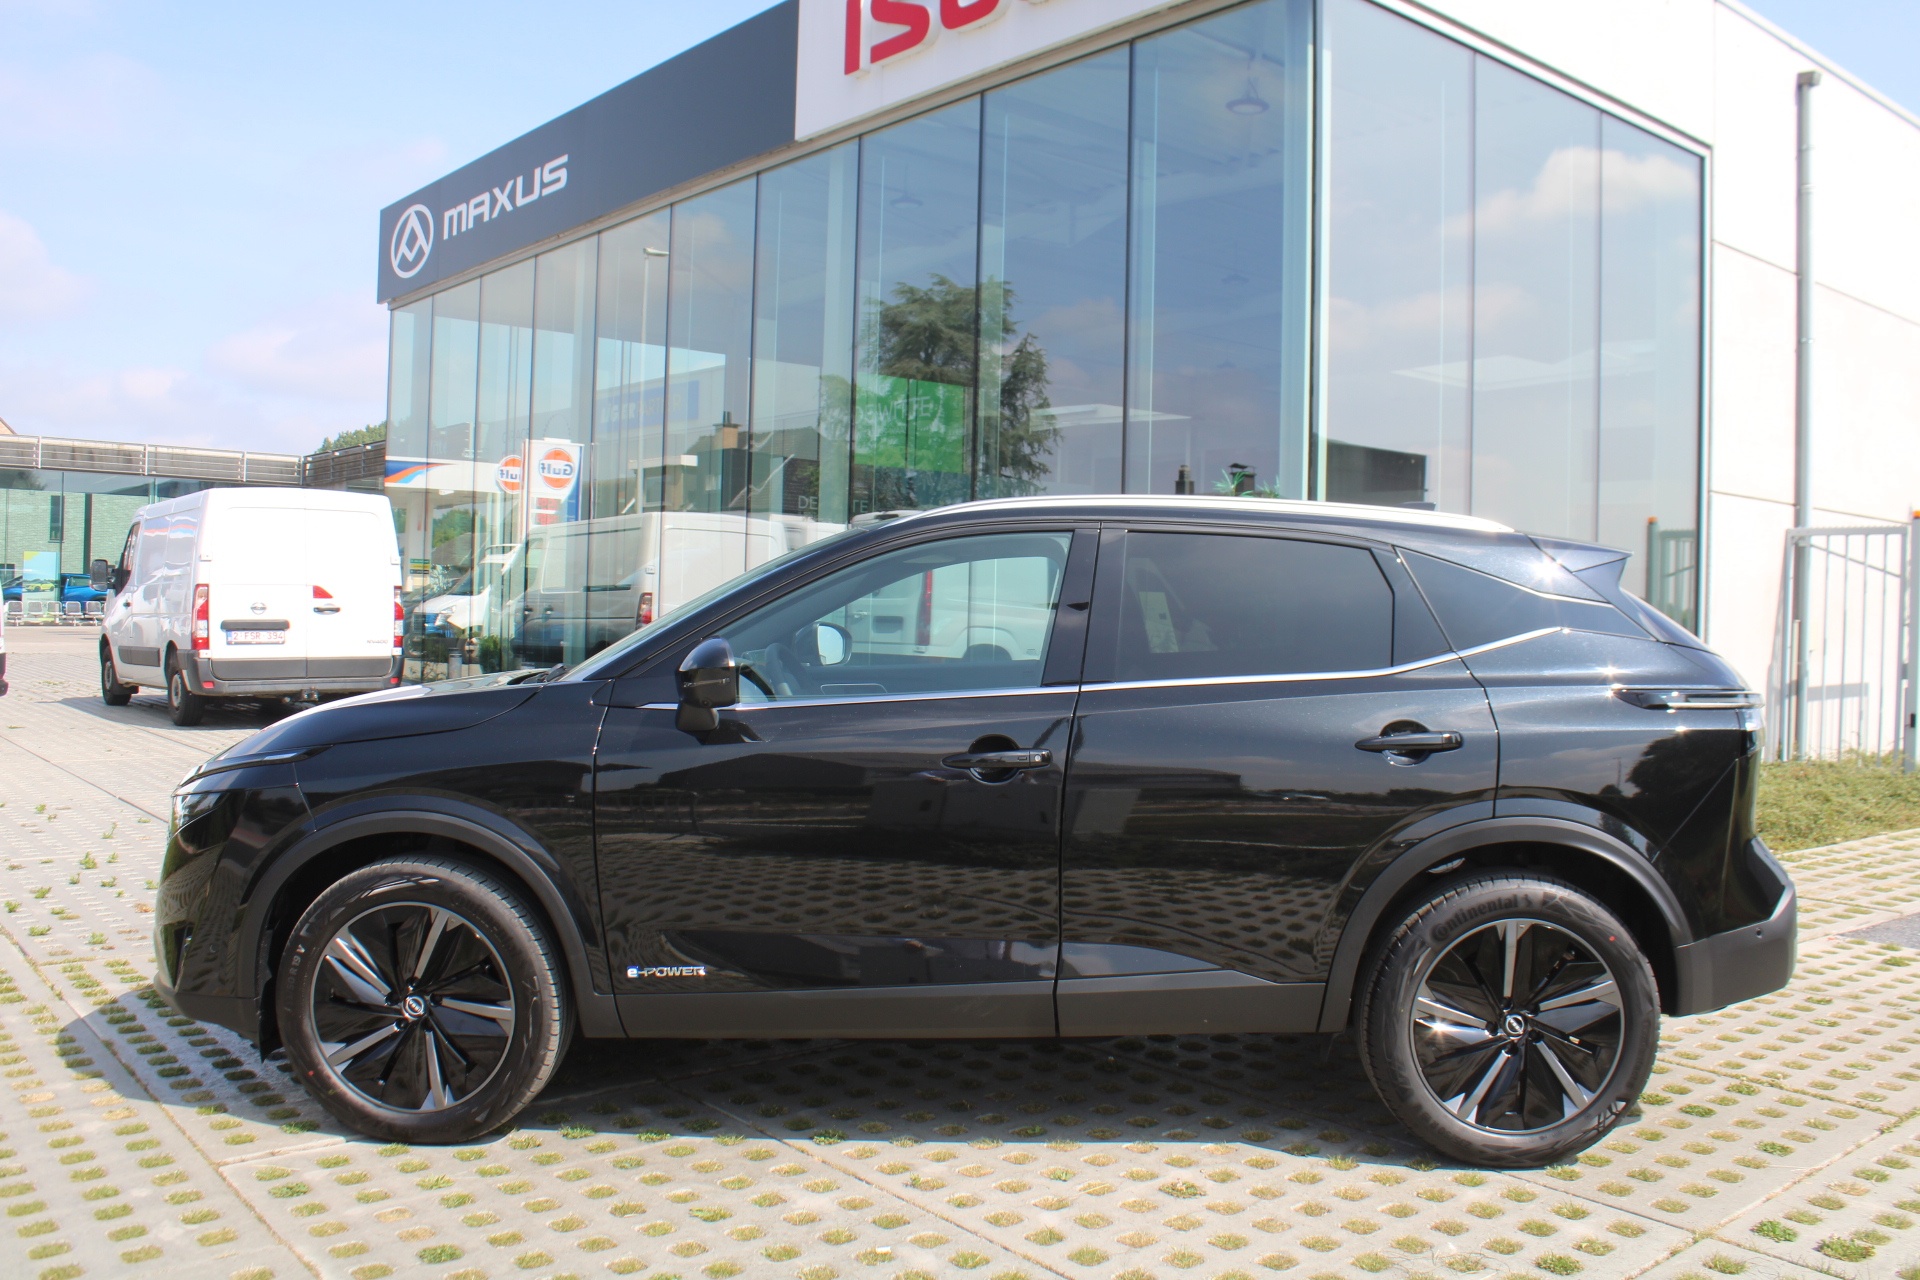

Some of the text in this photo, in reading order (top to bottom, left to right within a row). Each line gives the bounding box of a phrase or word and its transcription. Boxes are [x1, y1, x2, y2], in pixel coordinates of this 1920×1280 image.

[443, 153, 569, 240] MAXUS
[1430, 894, 1518, 941] Continental
[627, 966, 706, 978] e-POWER
